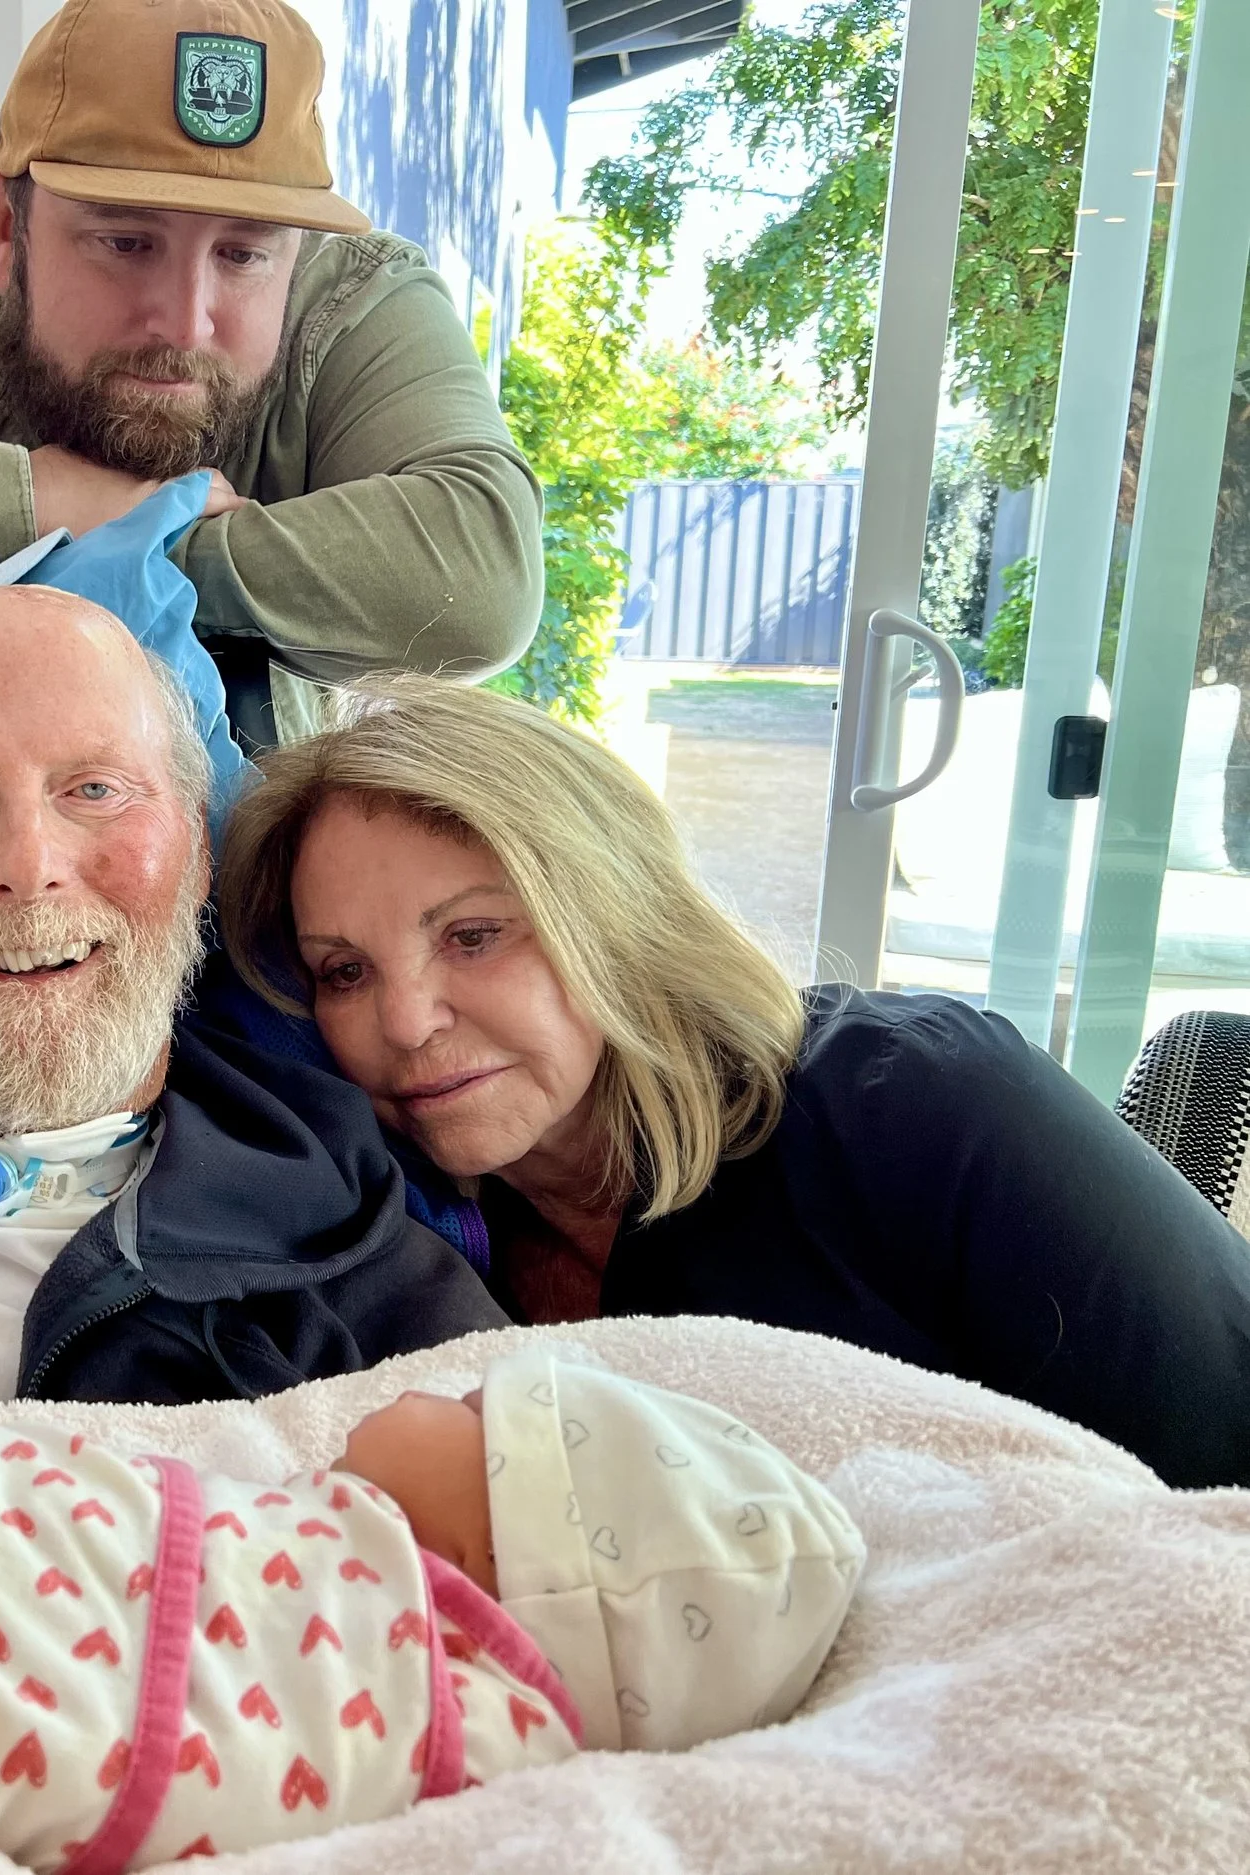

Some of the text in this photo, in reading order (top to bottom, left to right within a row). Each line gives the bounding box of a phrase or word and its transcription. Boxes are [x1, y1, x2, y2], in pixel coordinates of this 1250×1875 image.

[189, 42, 255, 56] HIPPYTREE
[188, 112, 208, 135] ESTD
[229, 119, 250, 138] MMIV
